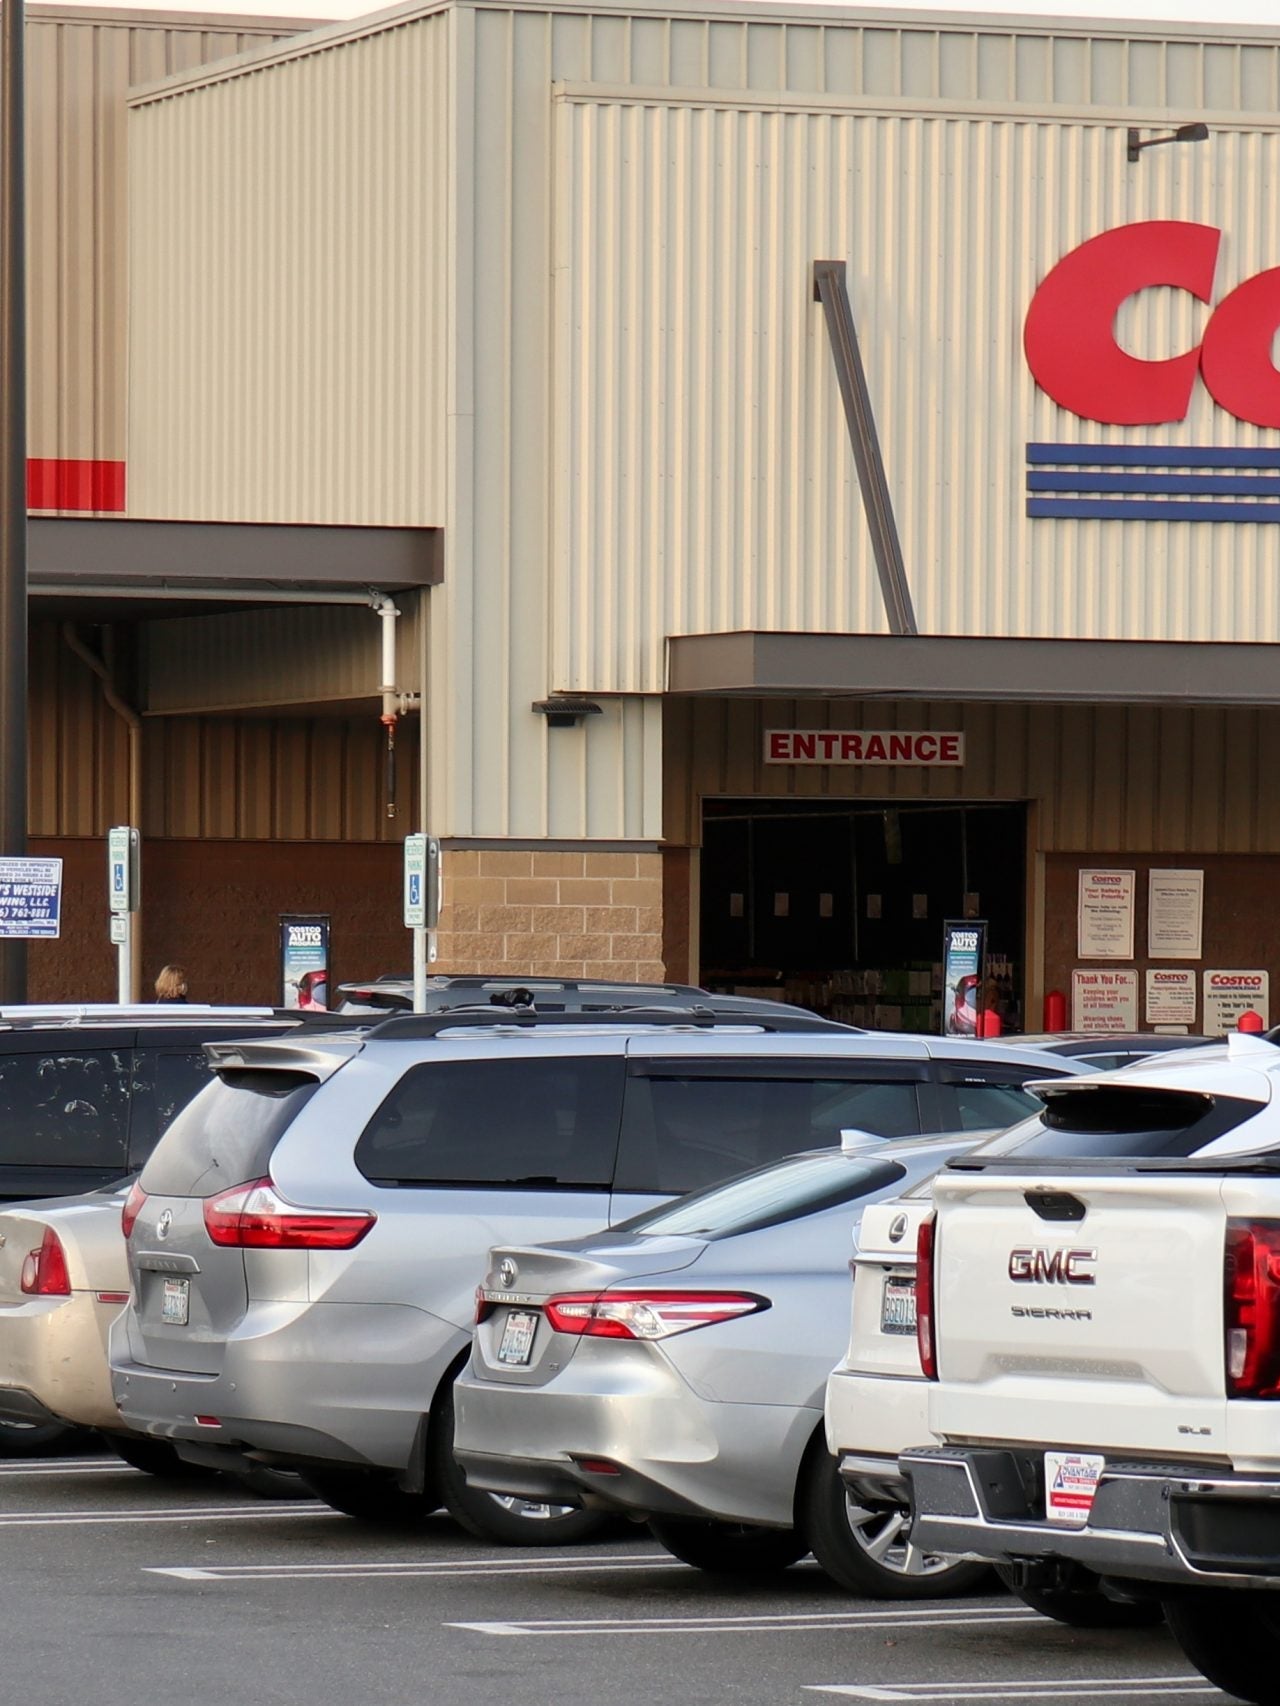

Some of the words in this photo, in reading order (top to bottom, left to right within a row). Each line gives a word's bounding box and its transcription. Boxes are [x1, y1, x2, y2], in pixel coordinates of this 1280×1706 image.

[770, 733, 959, 761] ENTRANCE
[13, 884, 57, 896] WESTSIDE
[289, 932, 322, 941] AUTO
[951, 938, 977, 946] AUTO
[1077, 973, 1098, 984] Thank
[1100, 973, 1114, 984] You
[1154, 972, 1188, 981] COSTCO
[1210, 974, 1262, 985] COSTCO
[1008, 1247, 1098, 1286] GMC
[1011, 1305, 1093, 1321] SIERRA
